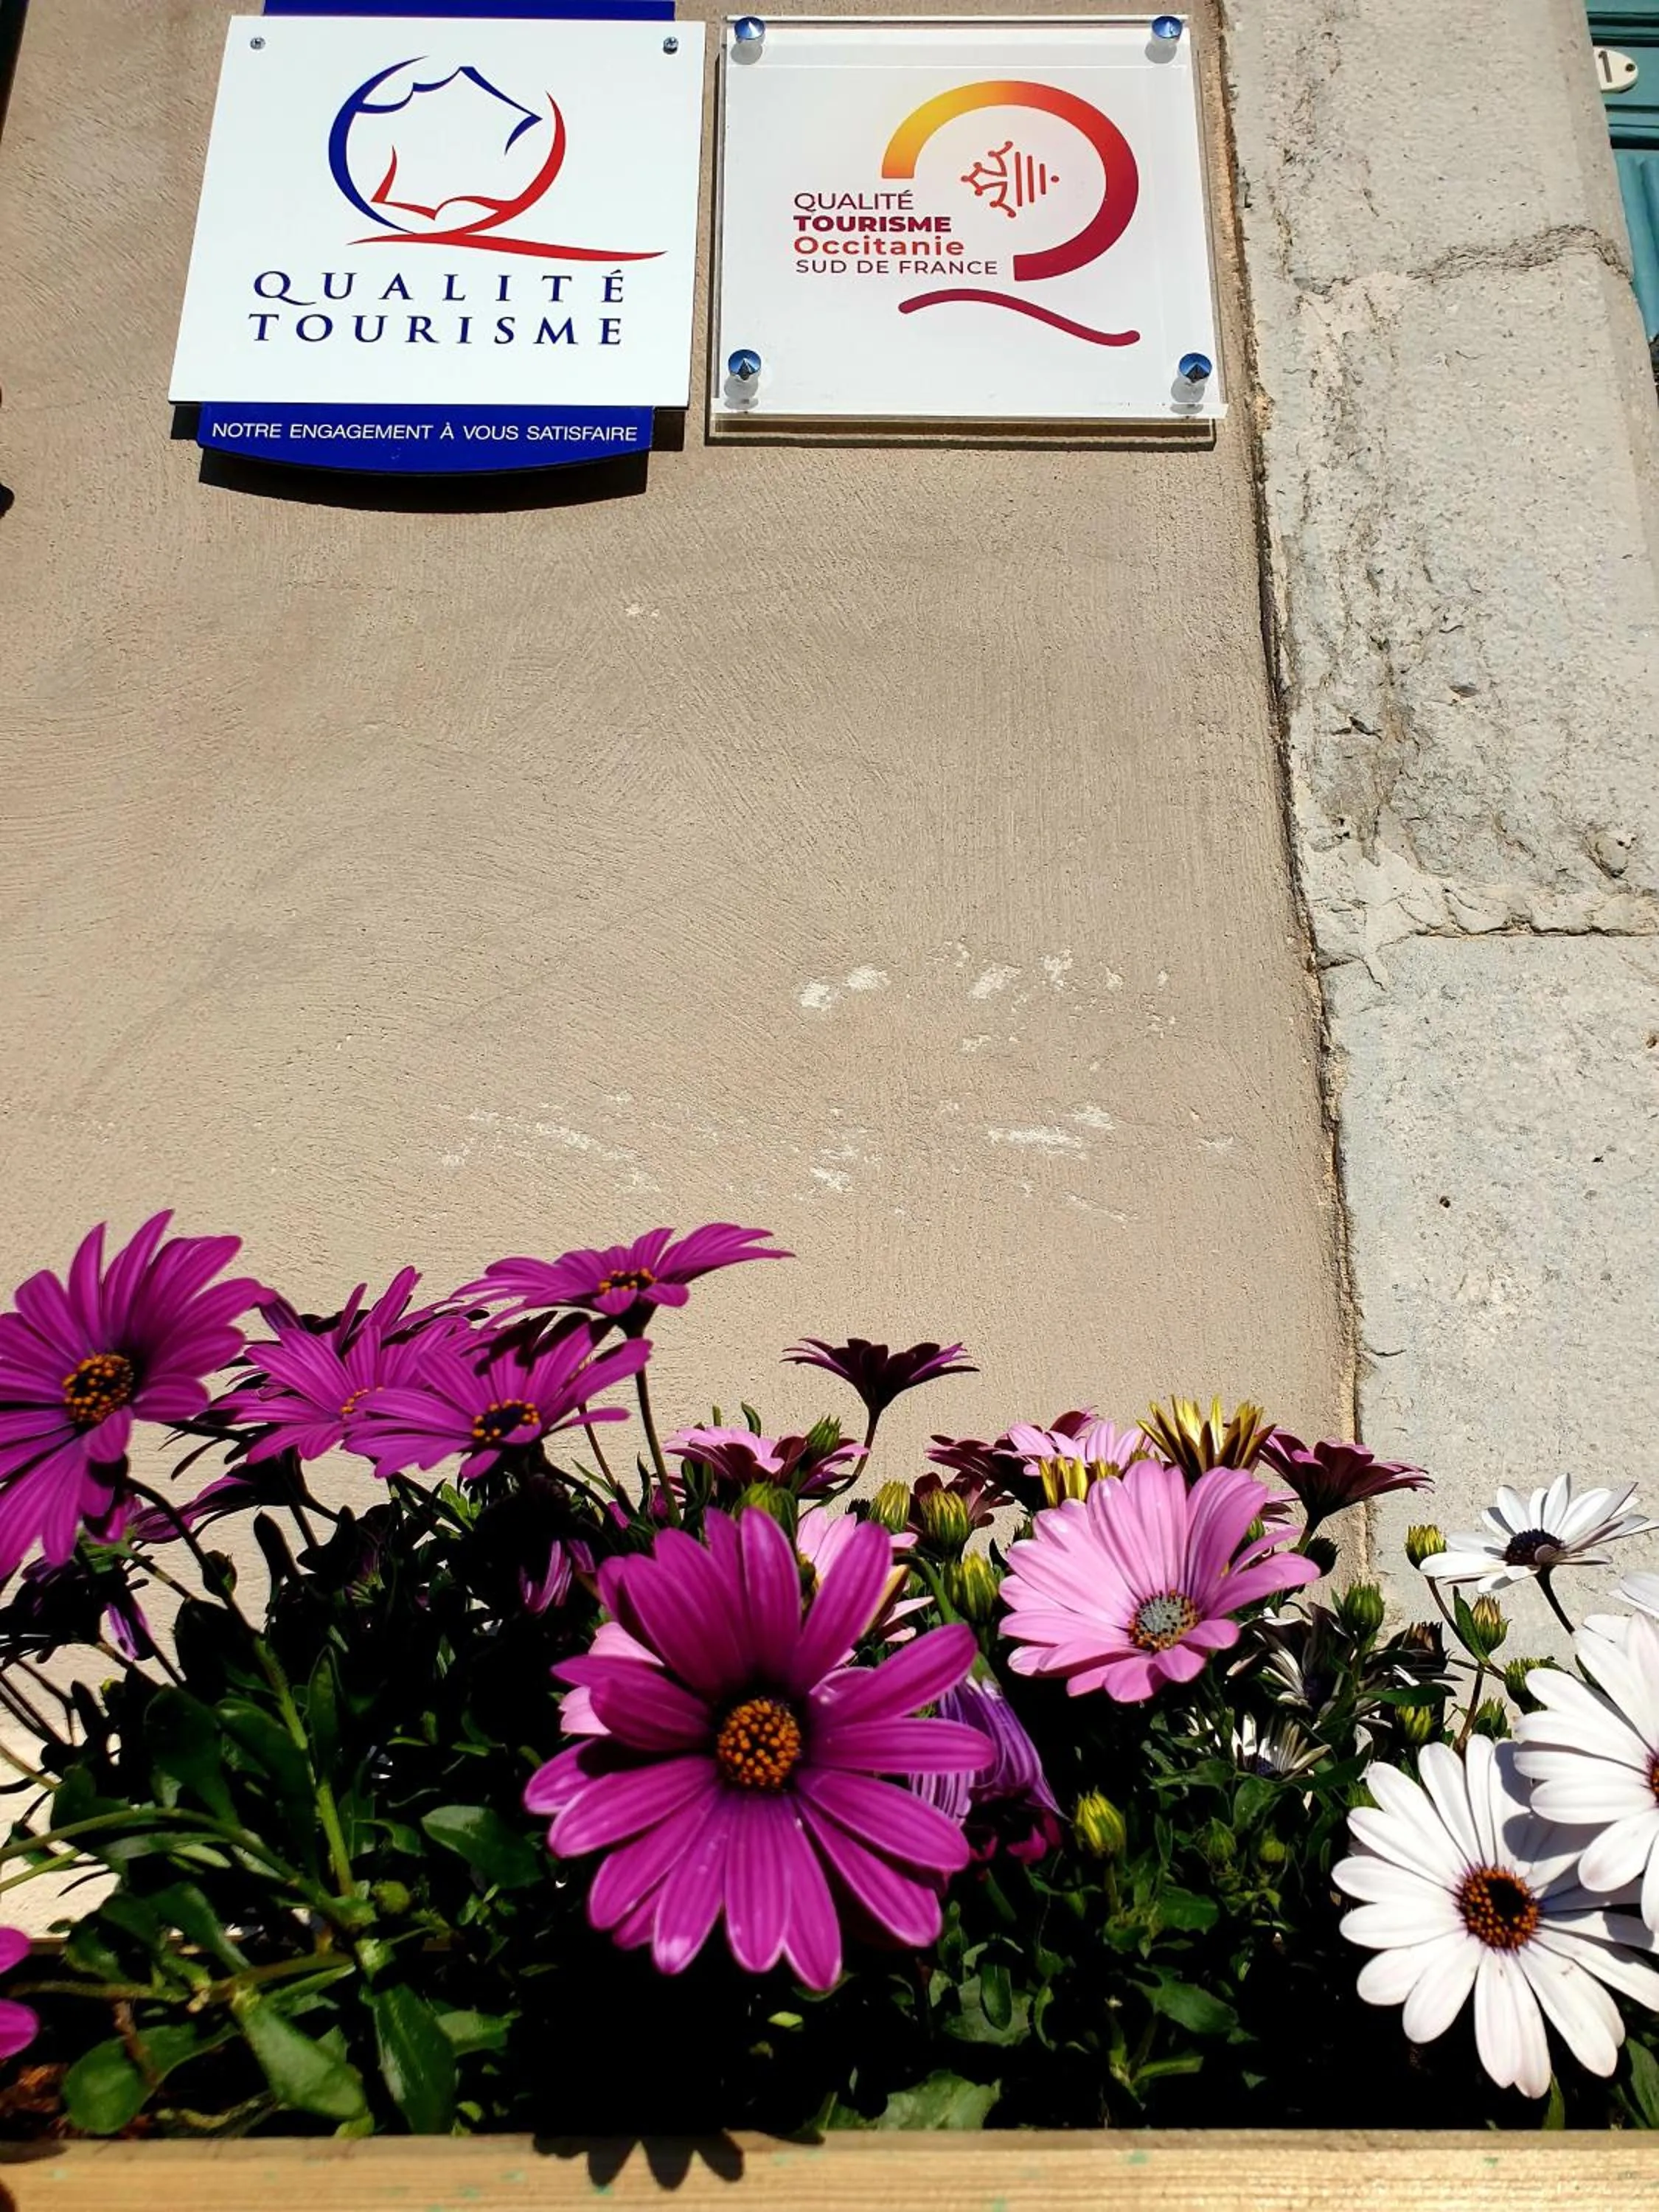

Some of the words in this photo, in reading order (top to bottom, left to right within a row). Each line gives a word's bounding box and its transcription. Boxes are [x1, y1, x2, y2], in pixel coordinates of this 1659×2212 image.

[794, 189, 914, 212] QUALITÉ
[793, 215, 951, 232] TOURISME
[794, 235, 964, 255] Occitanie
[796, 260, 846, 274] SUD
[858, 260, 888, 274] DE
[900, 261, 997, 274] FRANCE
[253, 268, 624, 305] QUALITÉ
[248, 313, 621, 345] TOURISME
[212, 422, 282, 439] NOTRE
[290, 423, 433, 439] ENGAGEMENT
[439, 422, 454, 440] À
[463, 425, 518, 441] VOUS
[526, 425, 637, 442] SATISFAIRE
